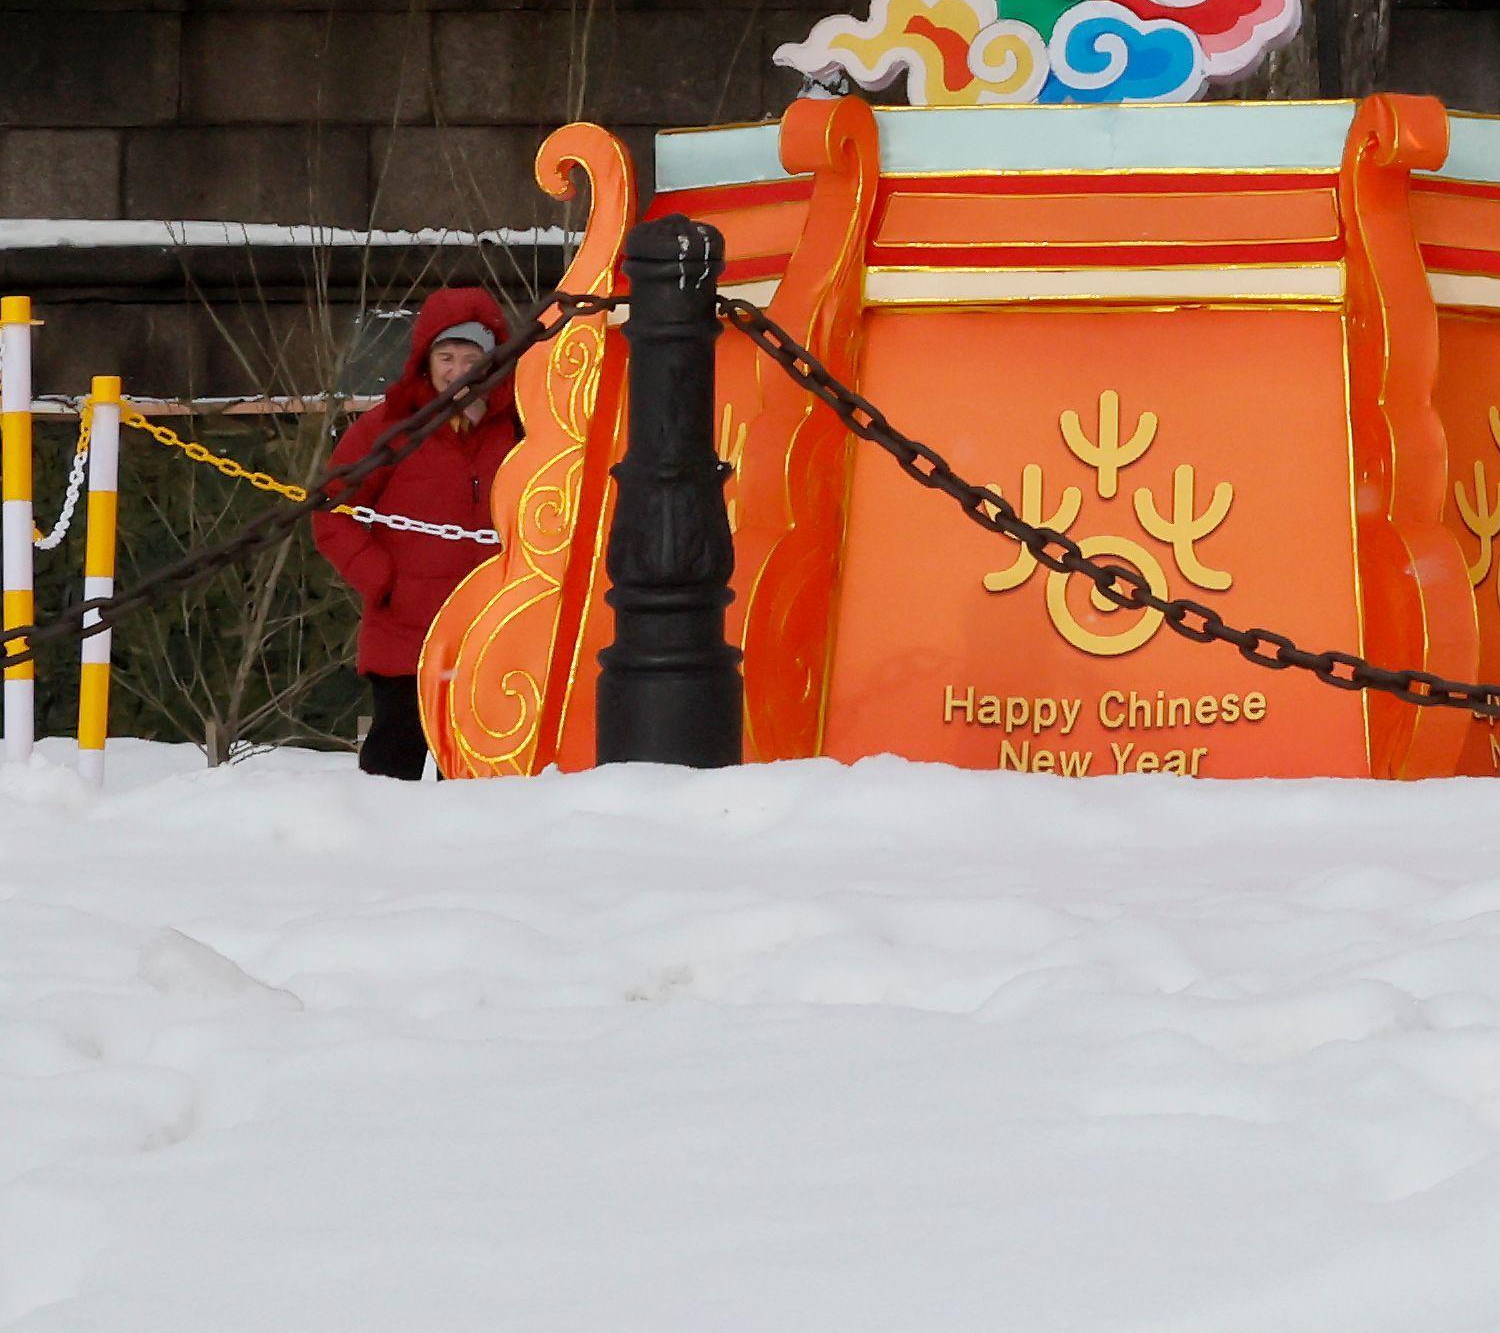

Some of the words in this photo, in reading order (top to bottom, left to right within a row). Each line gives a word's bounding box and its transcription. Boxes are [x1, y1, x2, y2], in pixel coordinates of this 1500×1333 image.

[944, 684, 1081, 734] Happy
[1099, 690, 1267, 728] Chinese
[1000, 740, 1092, 777] New
[1111, 742, 1208, 776] Year
